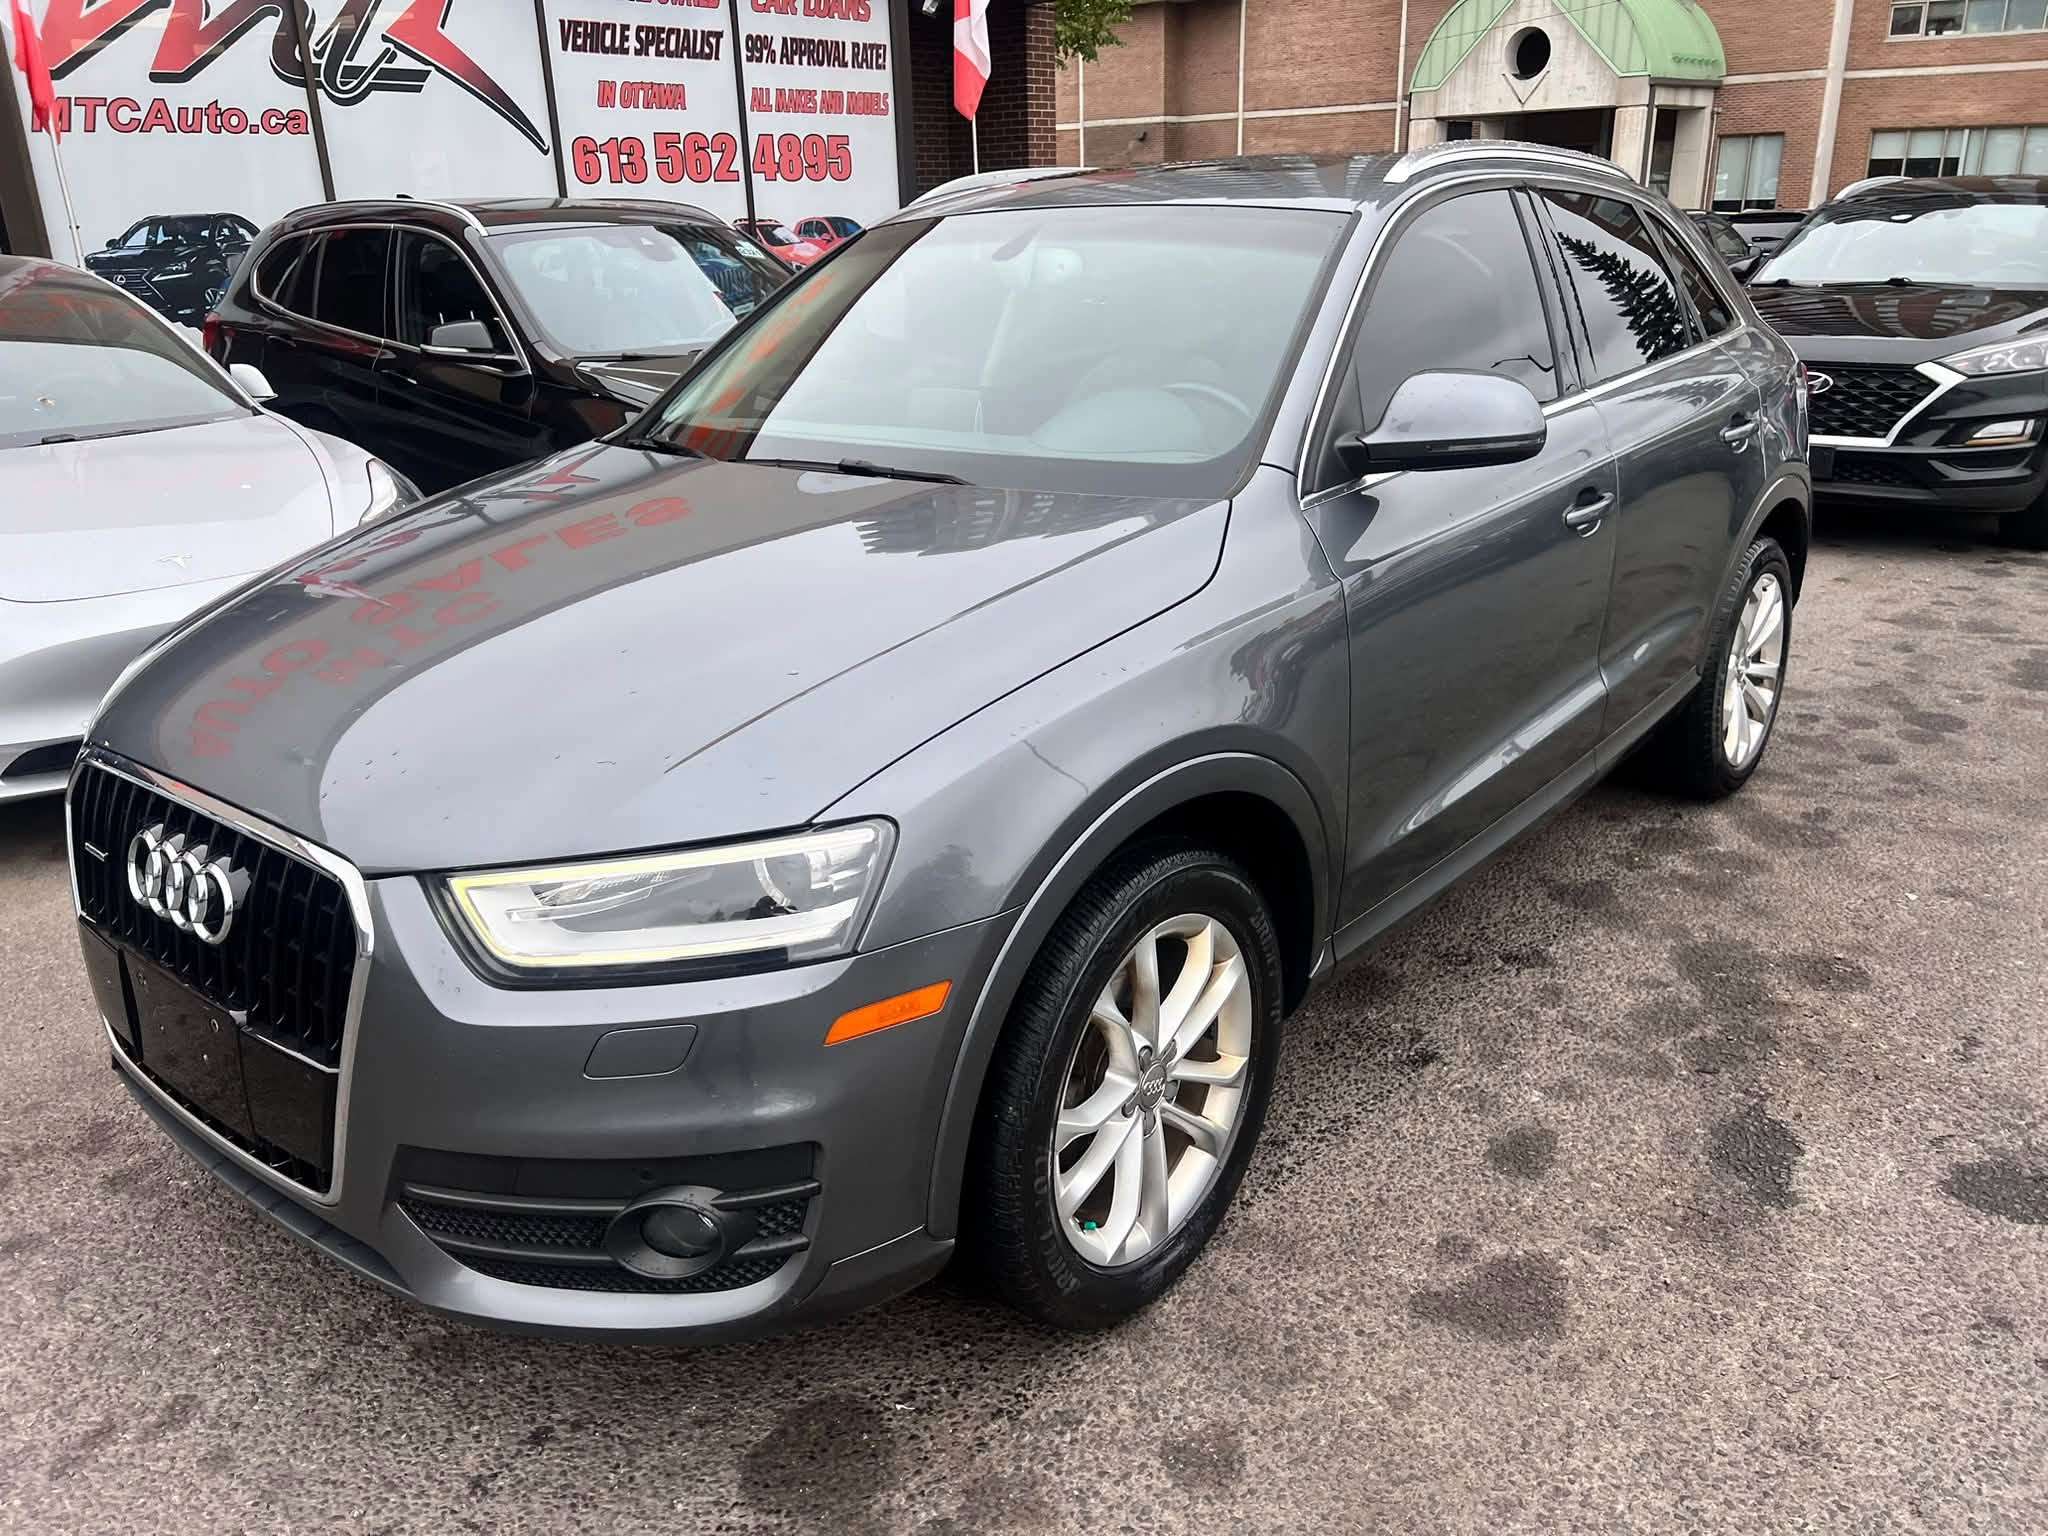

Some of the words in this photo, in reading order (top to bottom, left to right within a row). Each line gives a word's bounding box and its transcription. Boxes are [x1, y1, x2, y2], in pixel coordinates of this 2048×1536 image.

[559, 18, 631, 56] VEHICLE
[633, 24, 724, 61] SPECIALIST
[745, 33, 776, 64] 99%
[779, 36, 849, 68] APPROVAL
[851, 41, 887, 70] RATE!
[597, 80, 617, 108] IN
[620, 81, 687, 110] OTTAWA
[750, 87, 772, 112] ALL
[774, 88, 817, 113] MAKES
[819, 90, 844, 114] AND
[846, 91, 889, 116] MODELS
[571, 136, 648, 185] 613
[653, 132, 740, 183] 562
[752, 133, 852, 182] 4895
